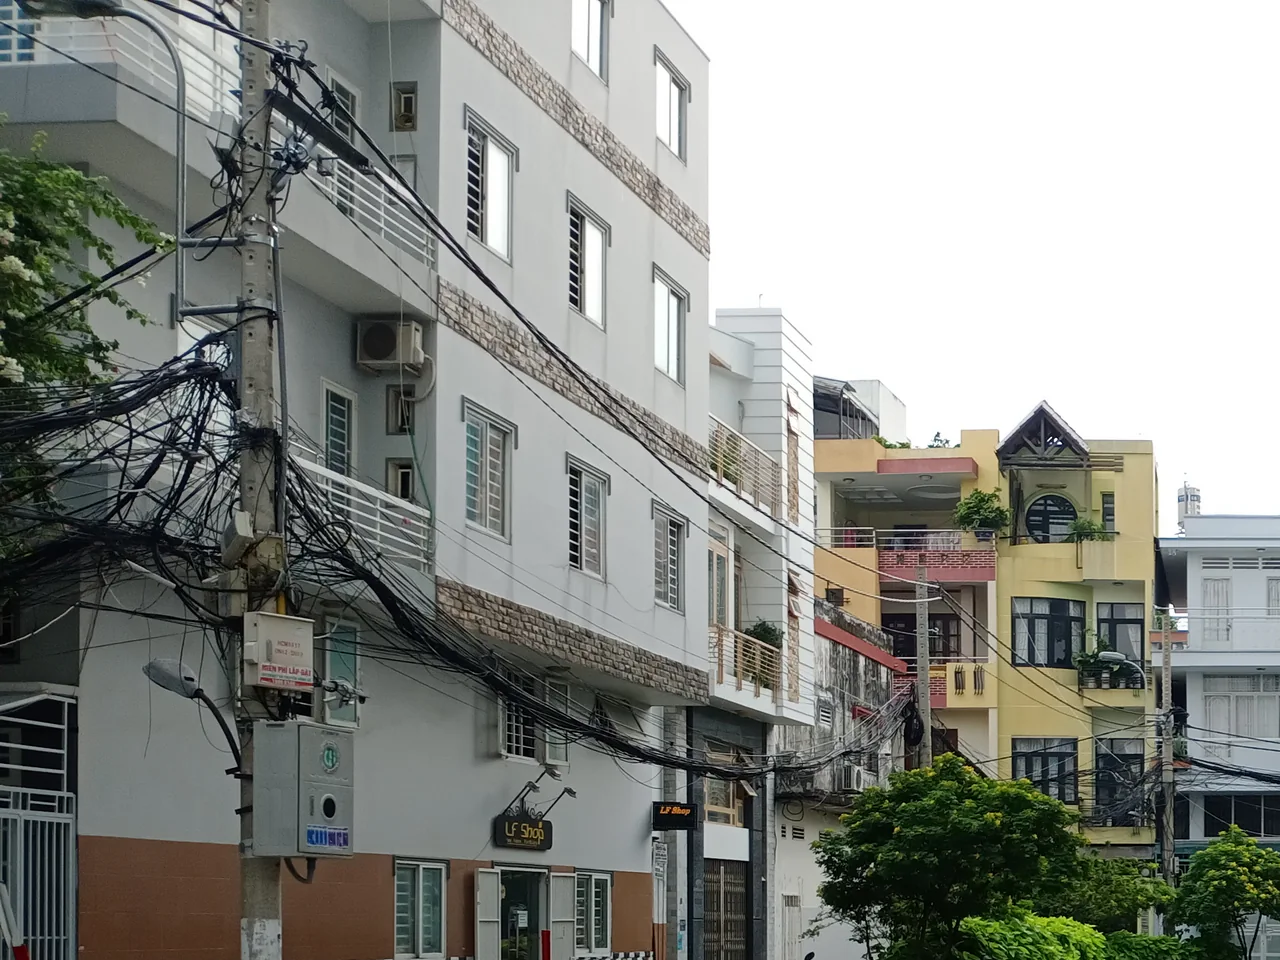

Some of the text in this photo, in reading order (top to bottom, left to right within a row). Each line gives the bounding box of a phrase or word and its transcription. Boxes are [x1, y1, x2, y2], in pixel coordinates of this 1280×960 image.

[659, 806, 691, 816] LF Shop
[505, 821, 544, 845] LF Shop
